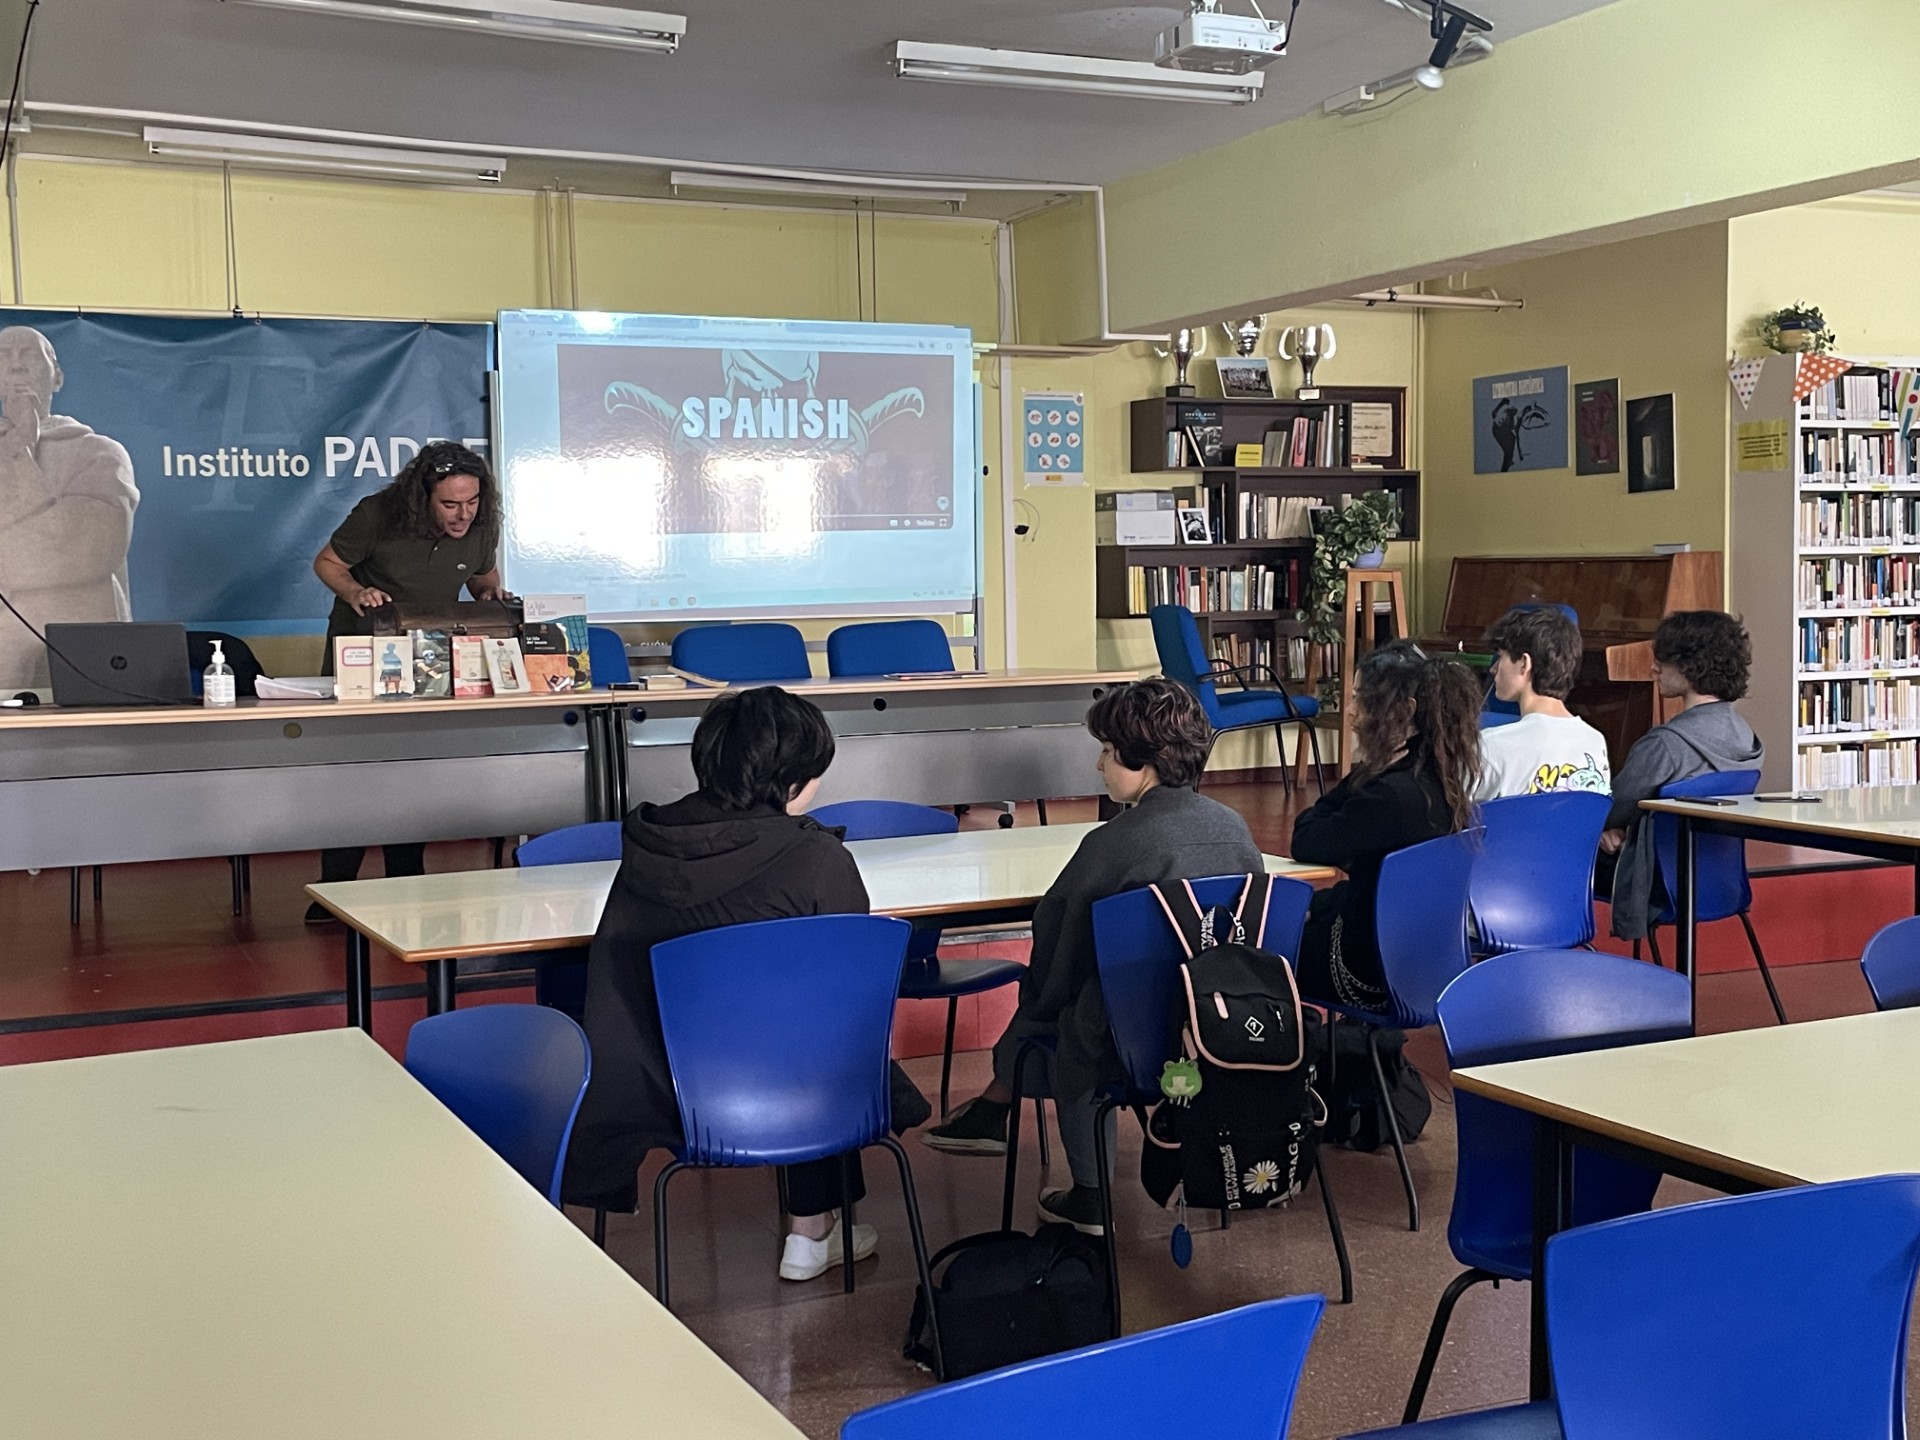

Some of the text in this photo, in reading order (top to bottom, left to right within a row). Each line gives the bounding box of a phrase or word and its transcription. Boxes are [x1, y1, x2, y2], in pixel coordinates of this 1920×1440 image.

[682, 396, 849, 439] SPANISH
[163, 436, 489, 478] Instituto PAD
